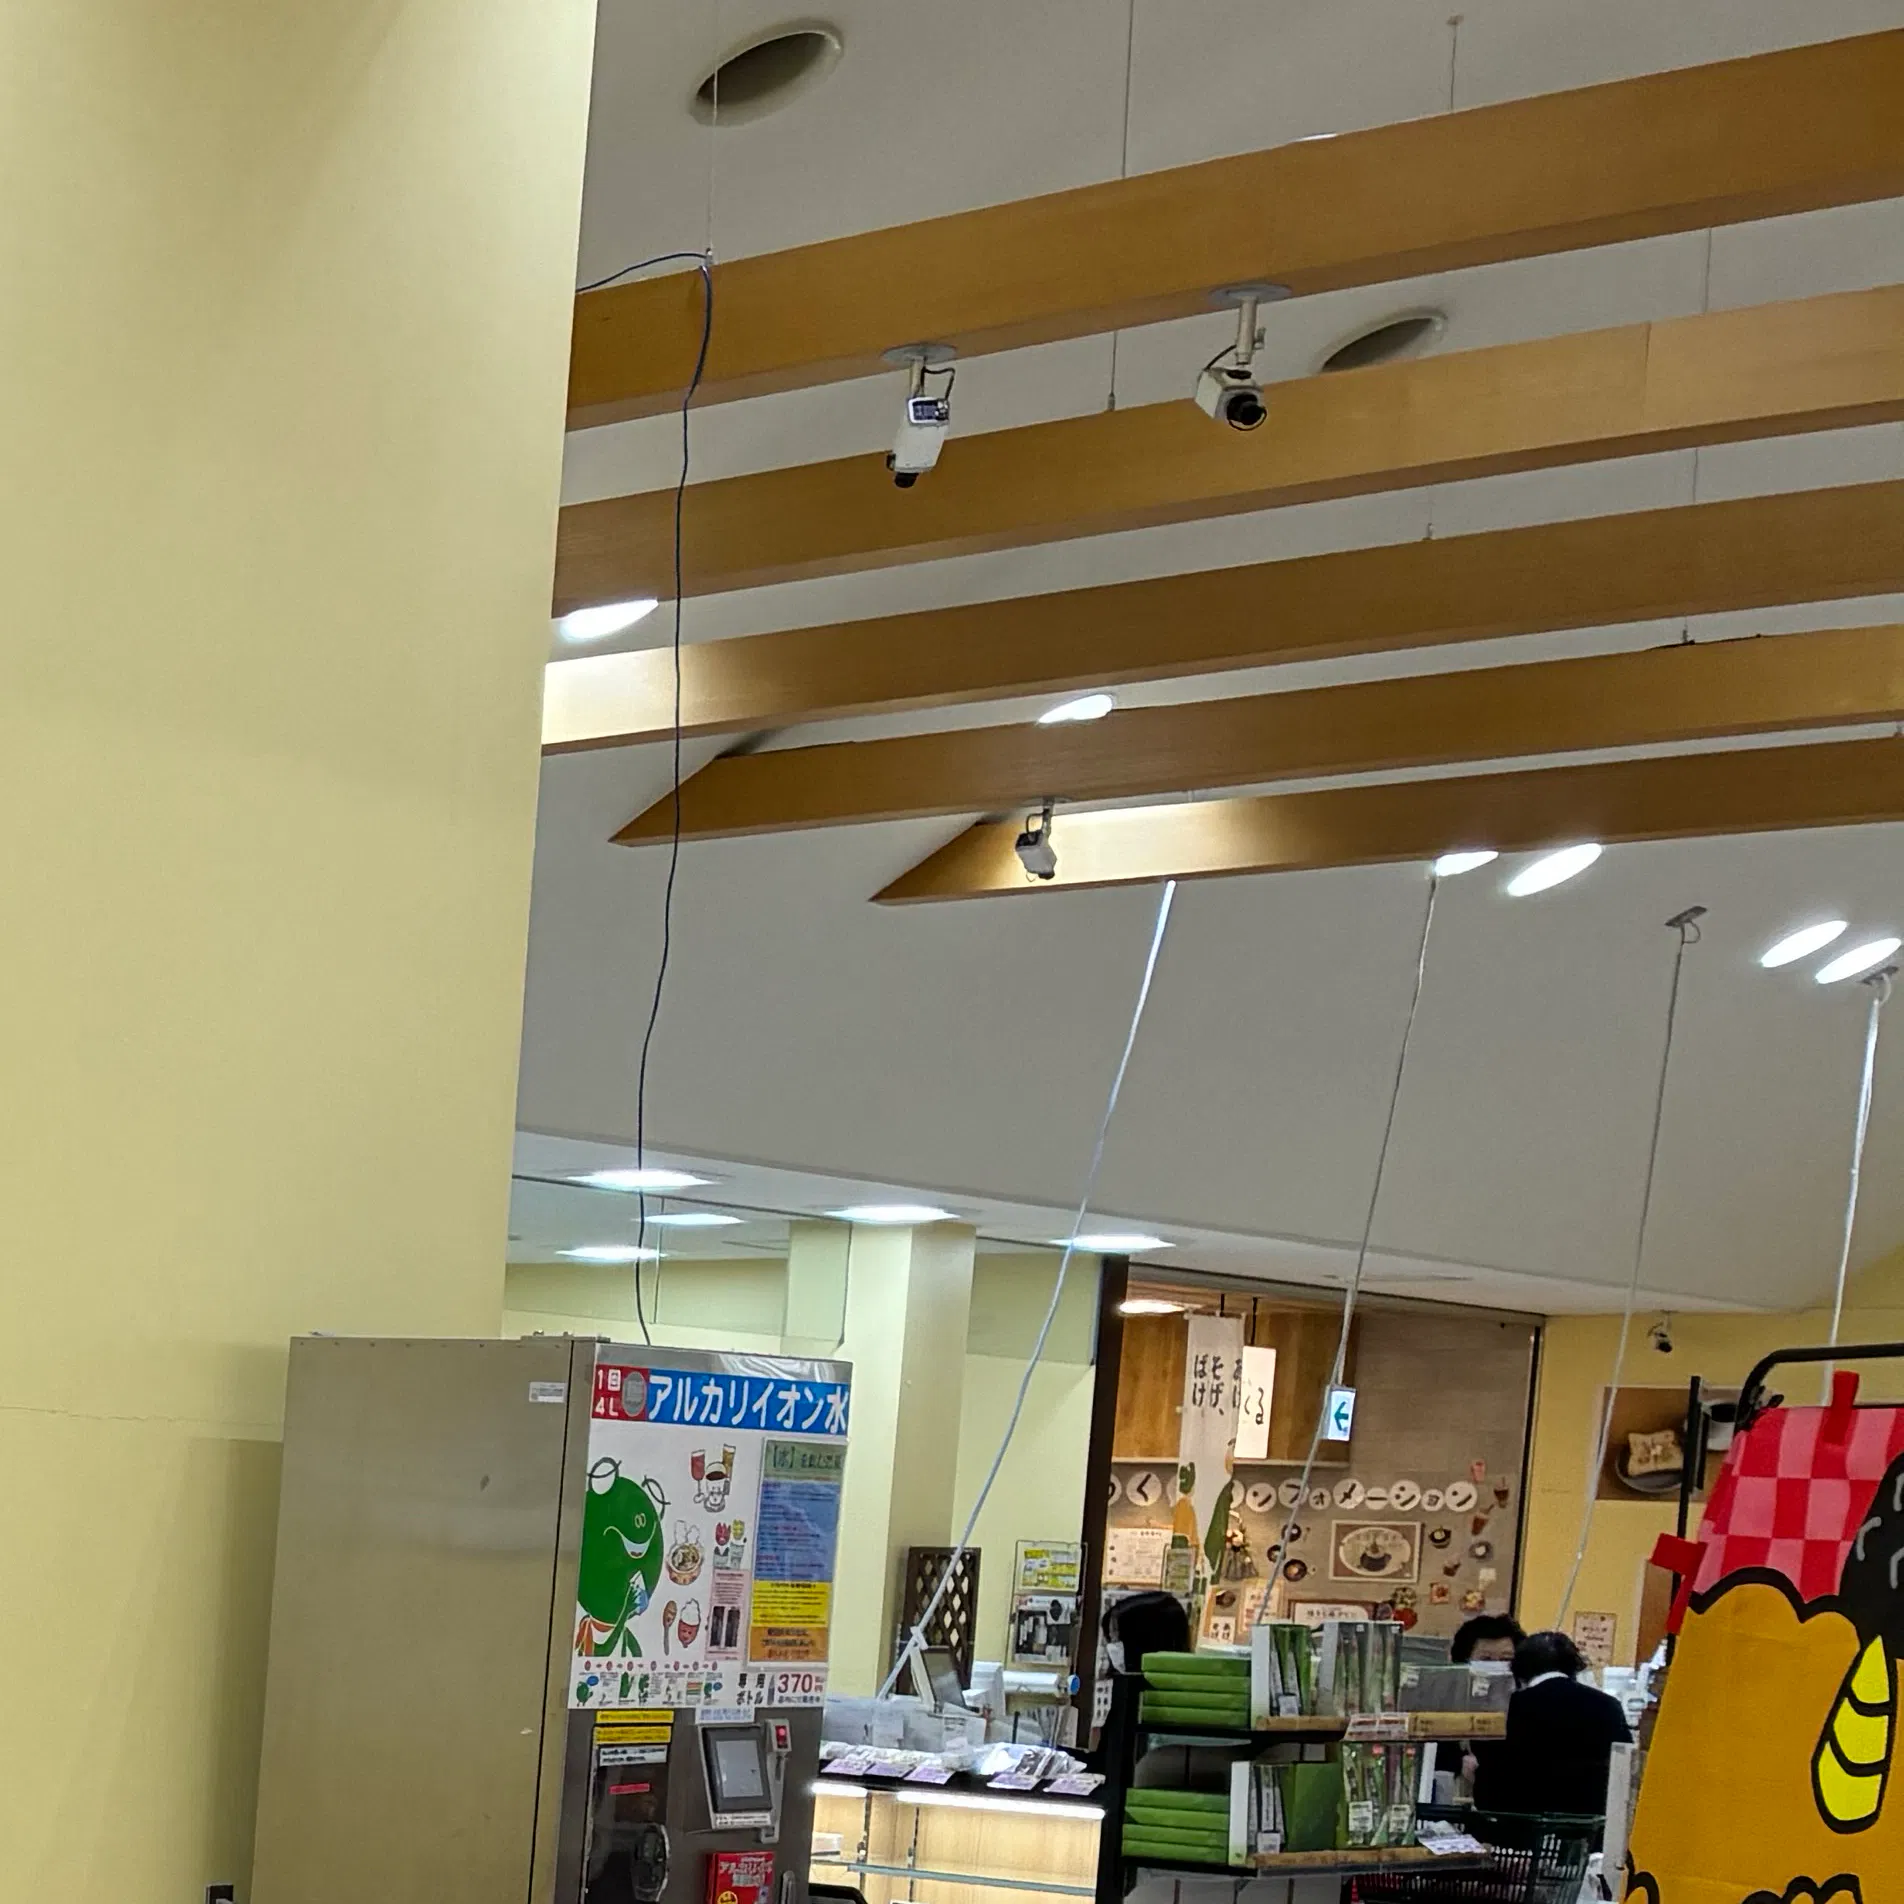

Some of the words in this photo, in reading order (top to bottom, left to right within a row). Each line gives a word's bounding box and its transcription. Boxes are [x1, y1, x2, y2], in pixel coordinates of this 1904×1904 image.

[648, 1374, 847, 1434] アルカリイオン水
[1250, 1481, 1473, 1509] ンフォメーション
[777, 1673, 813, 1694] 370
